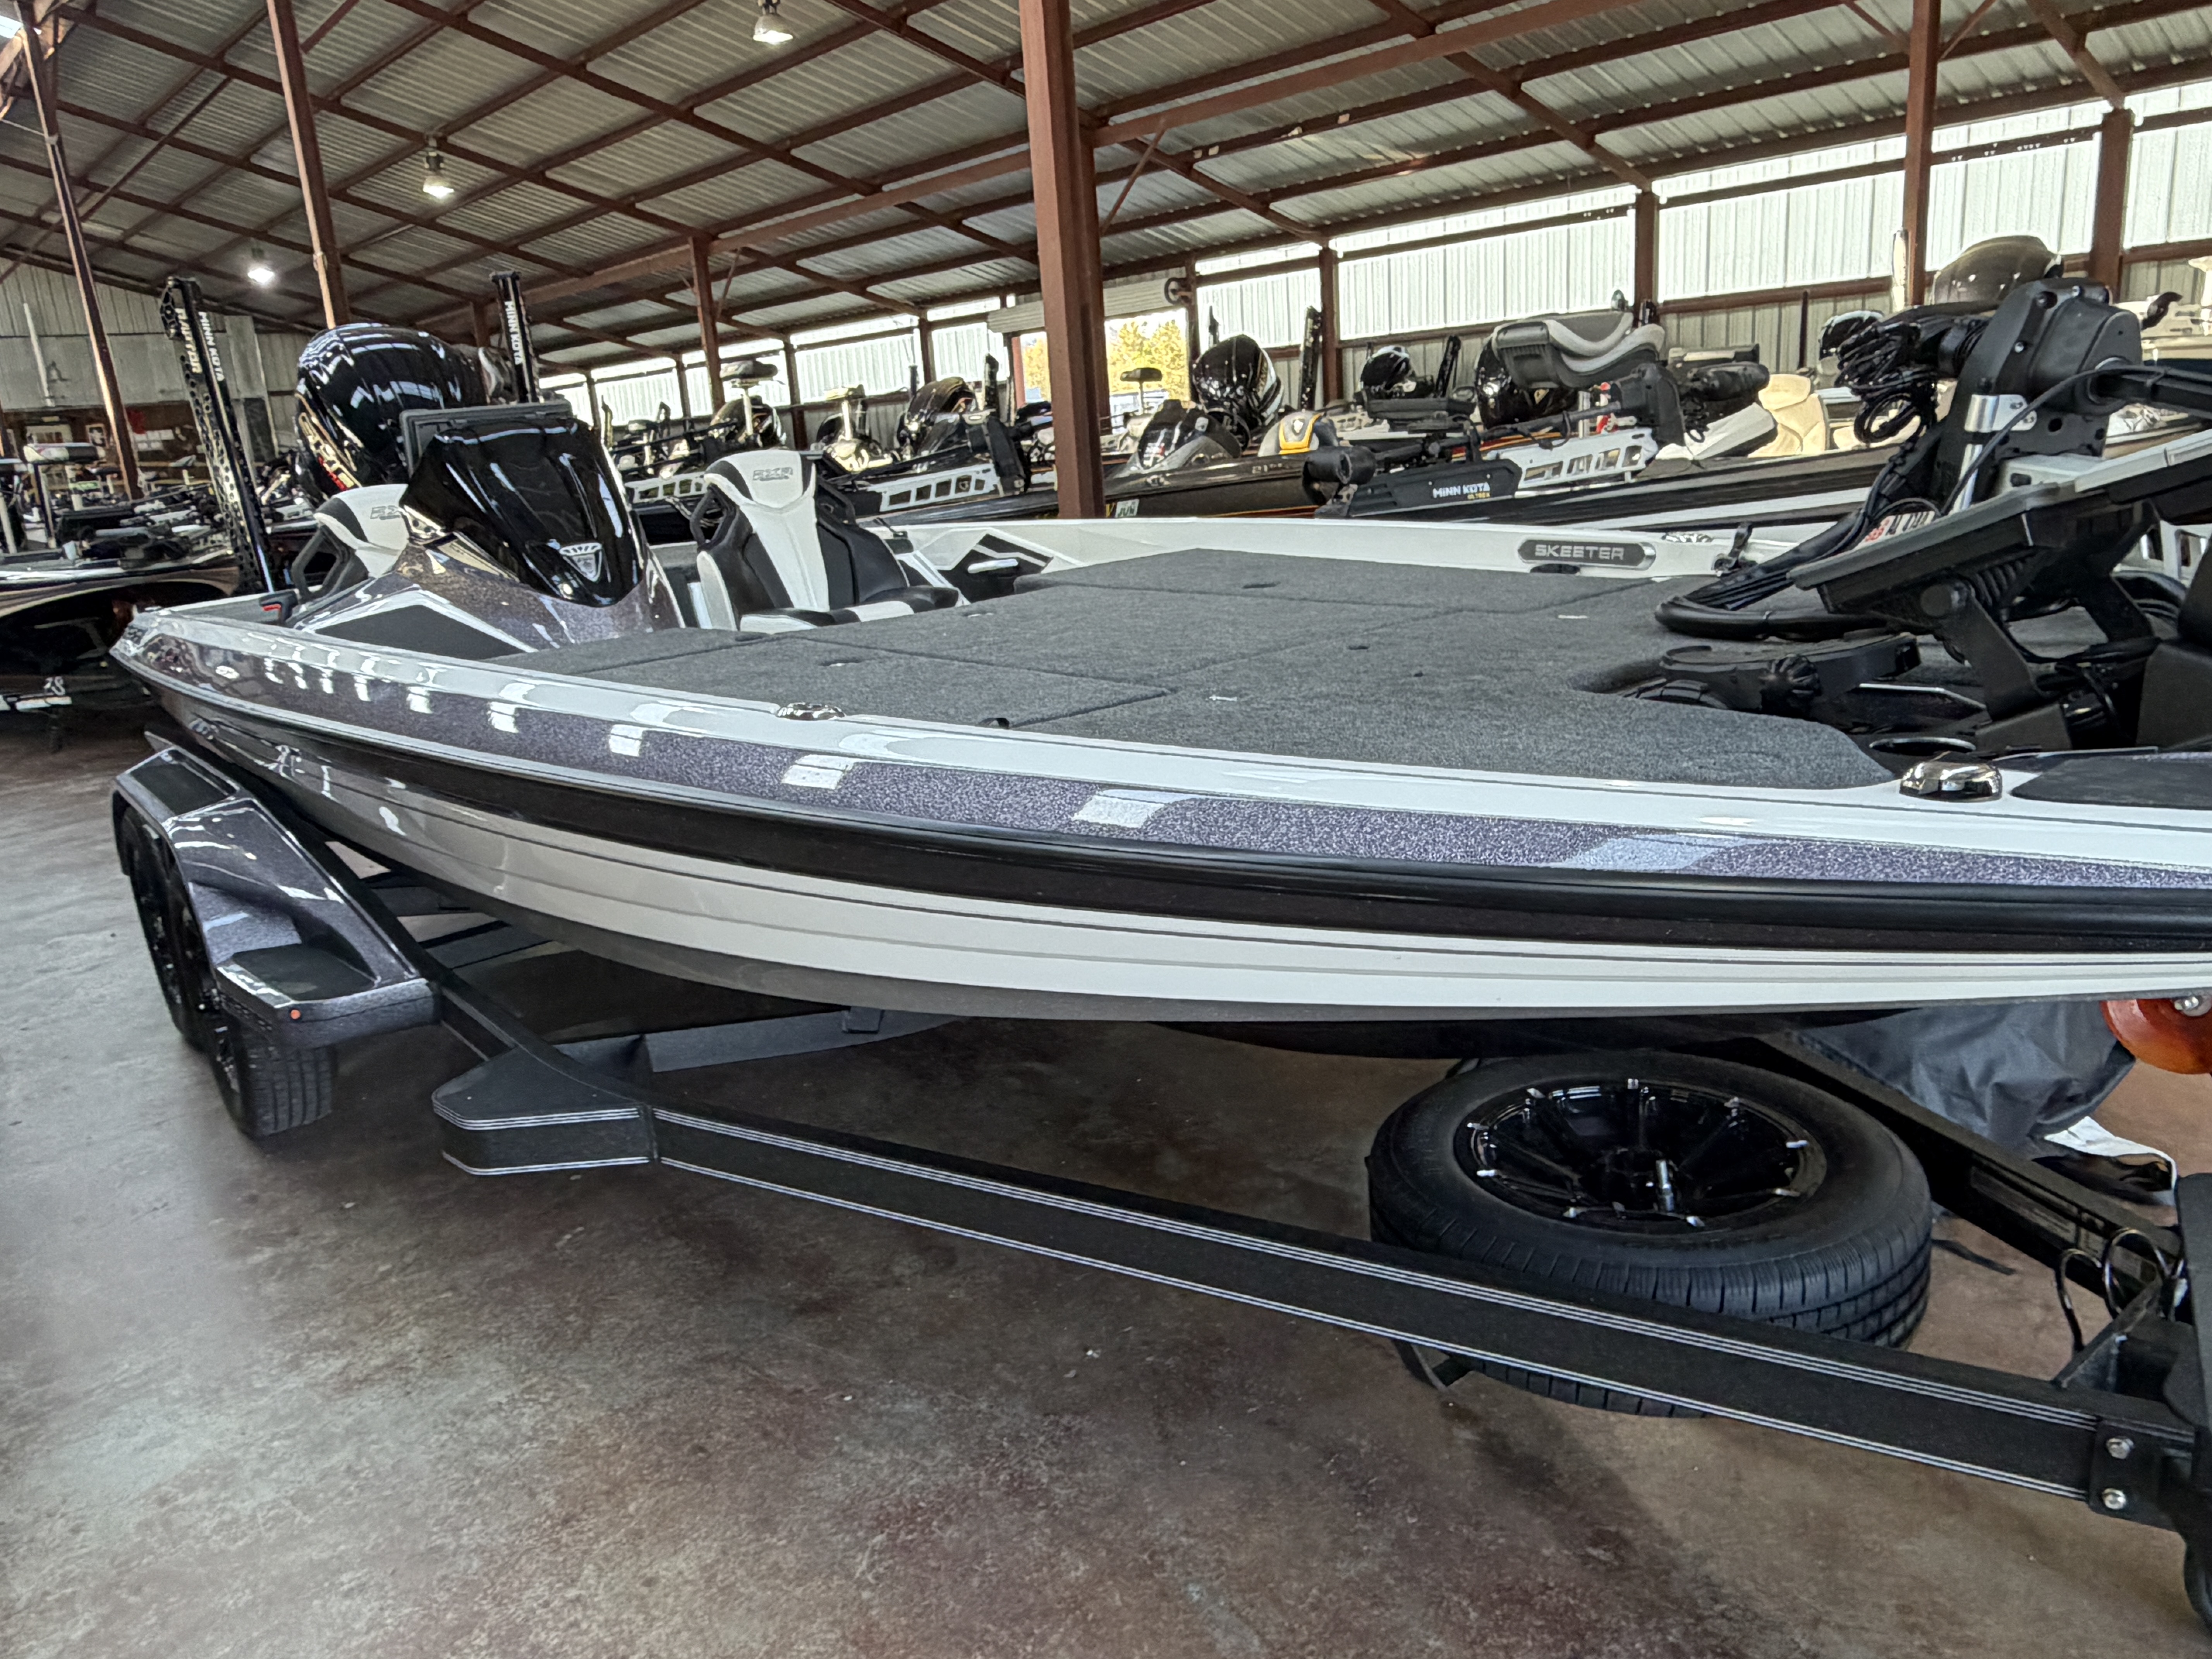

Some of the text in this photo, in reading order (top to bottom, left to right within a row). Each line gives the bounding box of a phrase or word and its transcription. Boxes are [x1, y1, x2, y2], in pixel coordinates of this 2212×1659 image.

[198, 311, 225, 381] MINN KOTA
[504, 301, 524, 365] MINN KOTA
[1432, 482, 1490, 498] MINN KOTA
[1535, 544, 1625, 560] SKEETER
